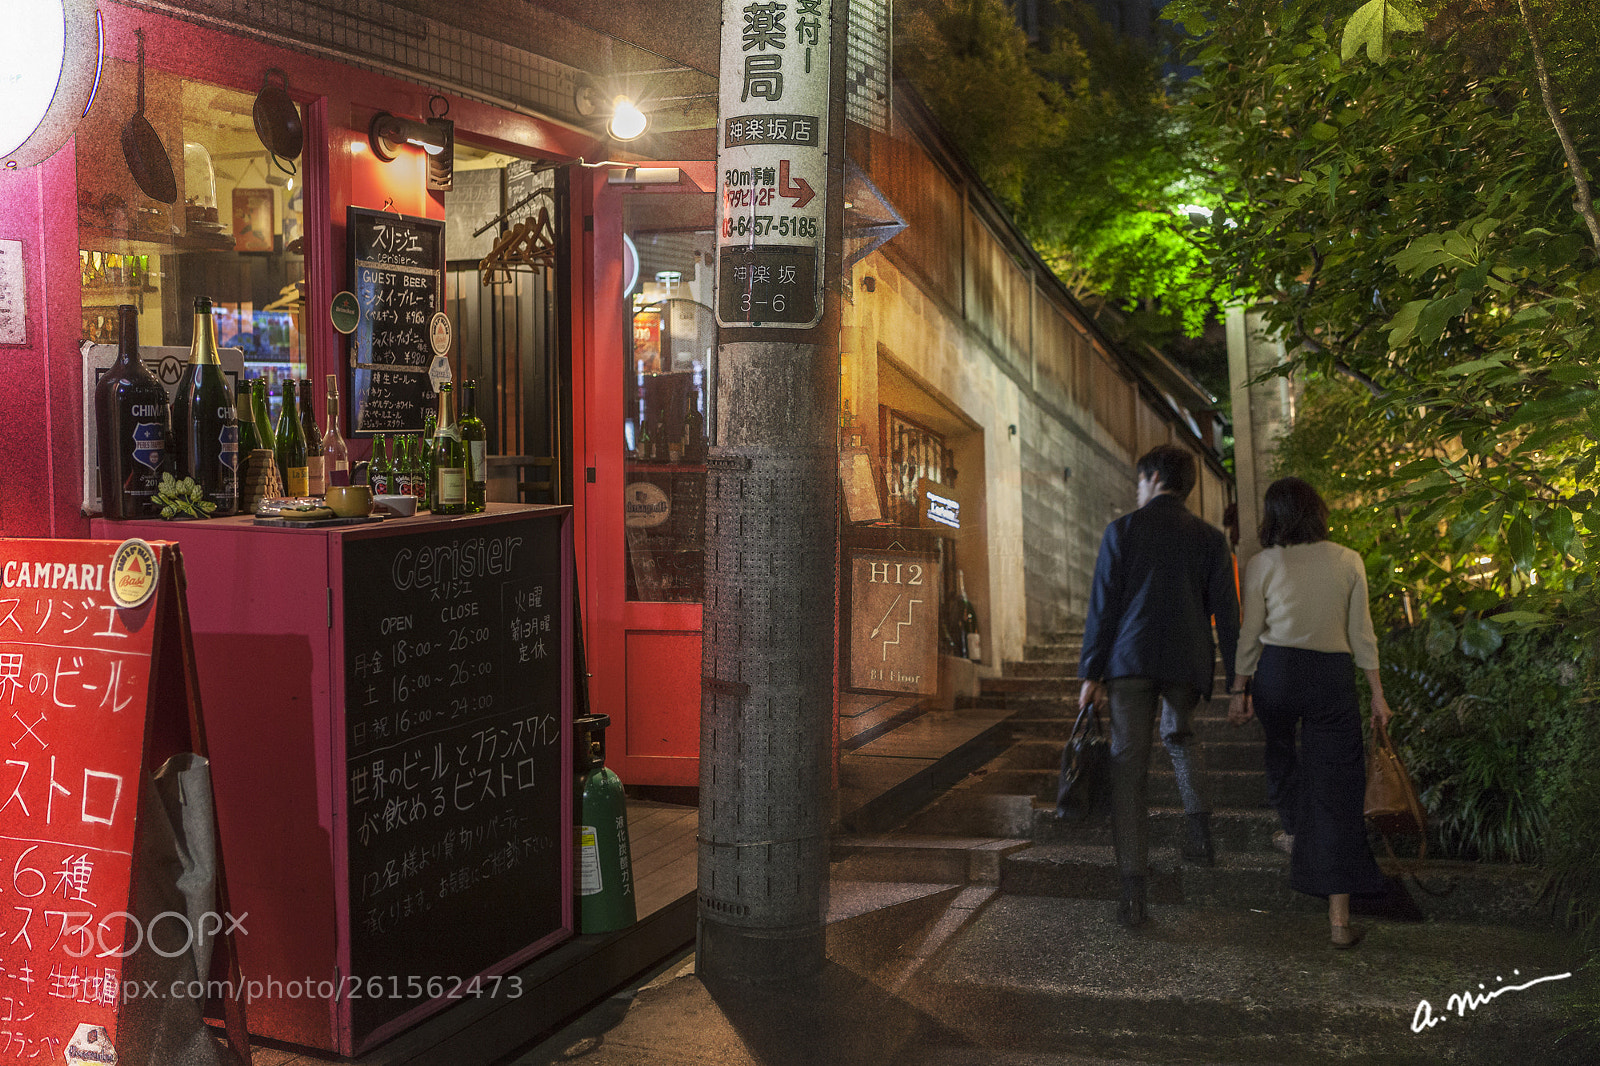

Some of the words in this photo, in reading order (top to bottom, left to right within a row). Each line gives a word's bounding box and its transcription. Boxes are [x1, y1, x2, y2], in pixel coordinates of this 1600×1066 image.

[741, 1, 788, 102] 薬局
[729, 118, 811, 143] 神楽坂店
[722, 215, 817, 238] 03-6457-5185
[363, 269, 397, 286] GUEST
[403, 275, 428, 288] BEER
[733, 265, 797, 285] 神楽坂
[3, 560, 105, 591] CAMPARI
[514, 585, 543, 613] 火曜
[380, 614, 413, 635] OPEN
[440, 602, 480, 623] CLOSE
[518, 638, 548, 664] 定休
[362, 684, 380, 706] 土
[0, 755, 123, 826] ストロ
[0, 906, 122, 959] スワイン
